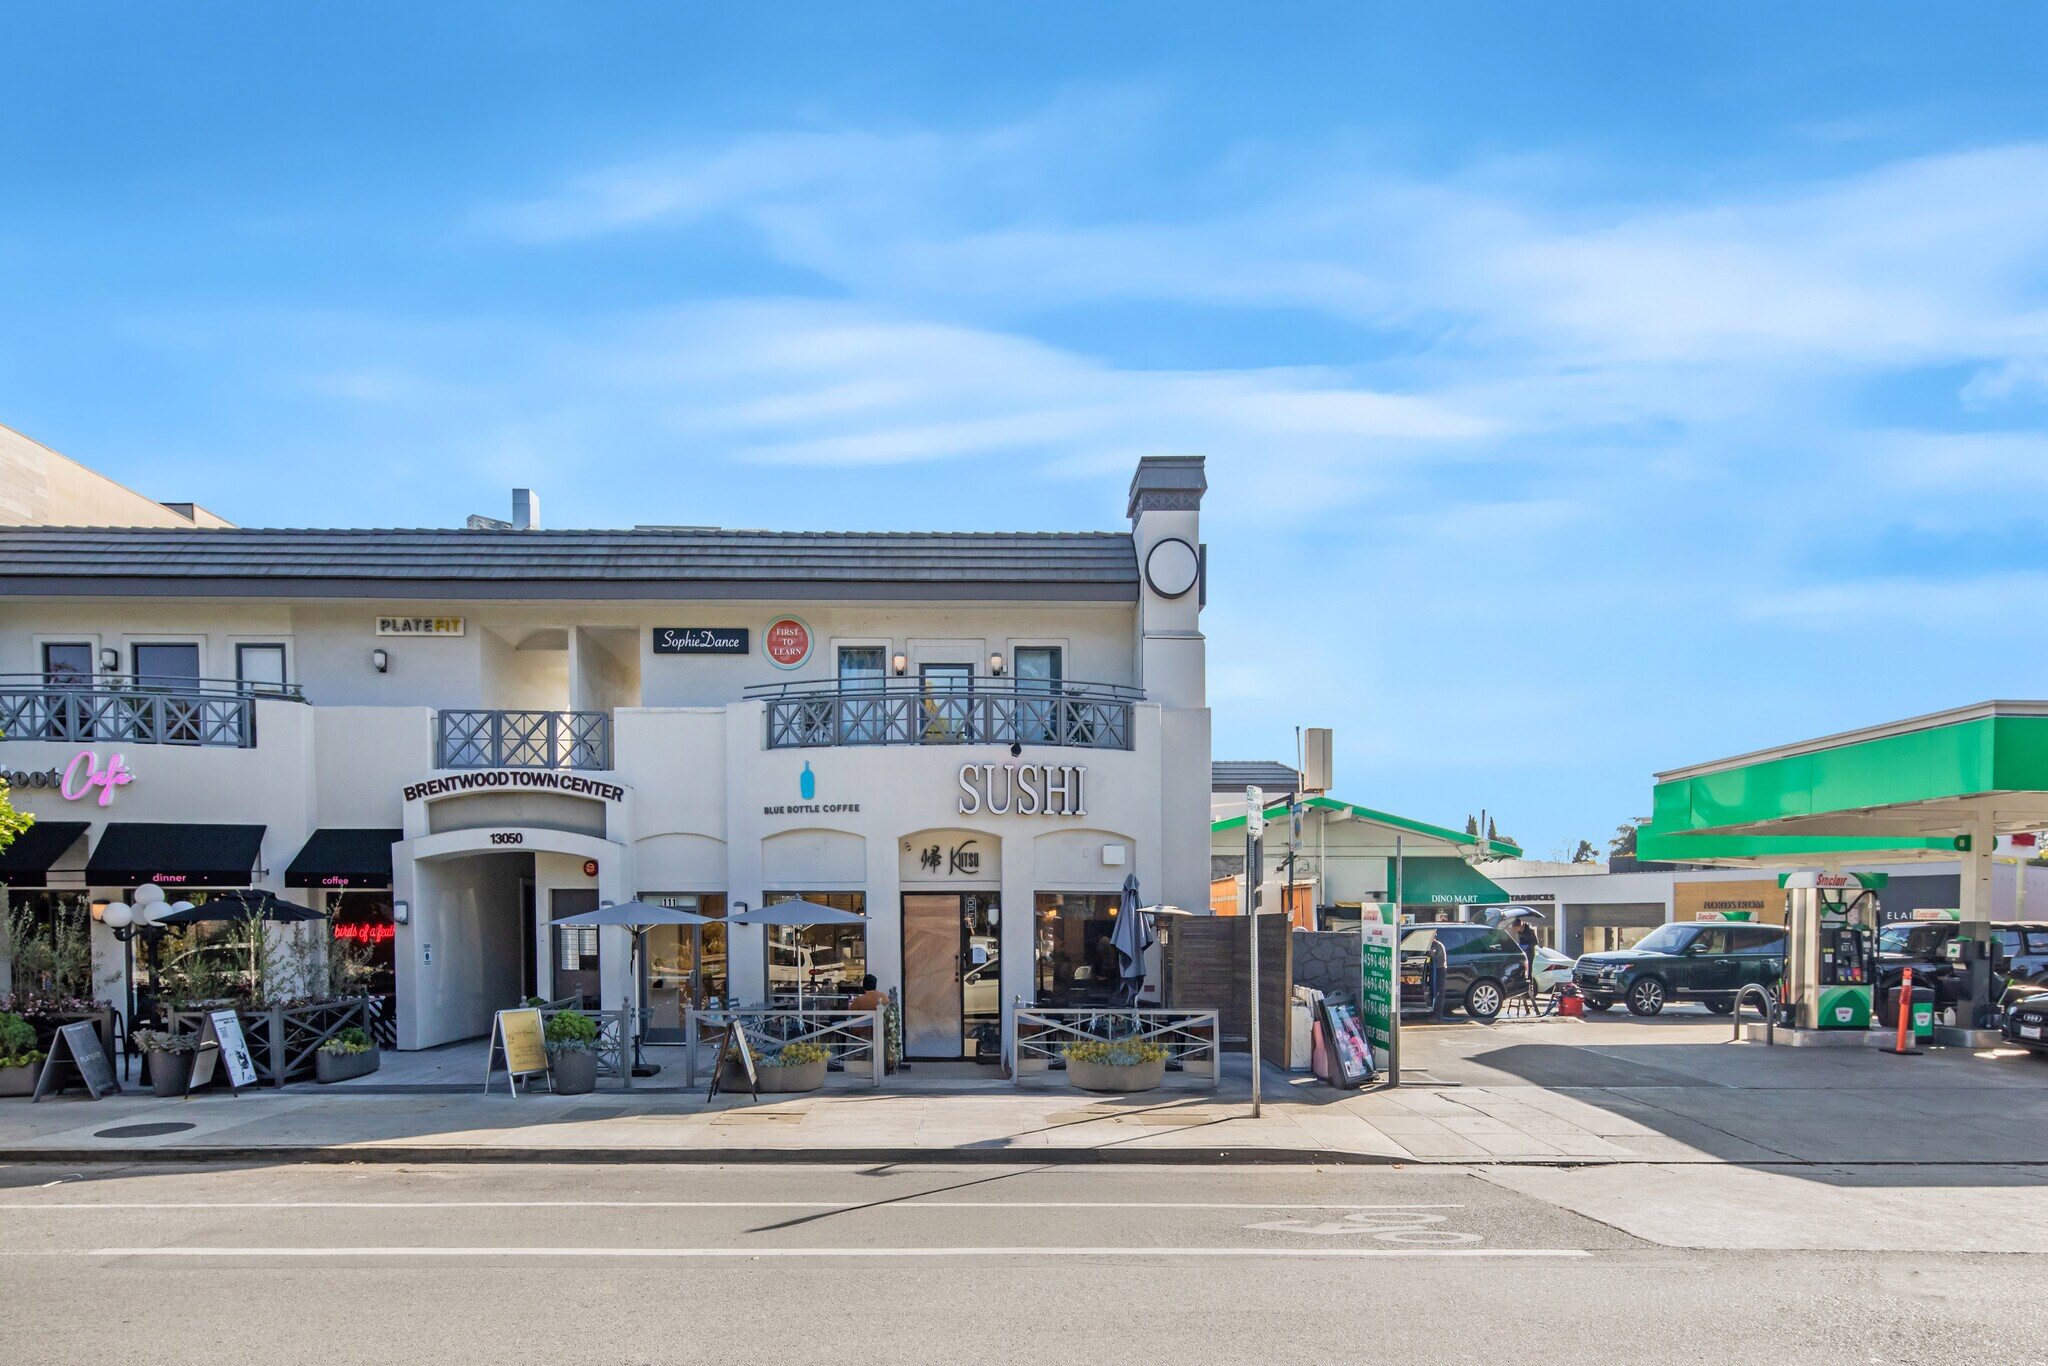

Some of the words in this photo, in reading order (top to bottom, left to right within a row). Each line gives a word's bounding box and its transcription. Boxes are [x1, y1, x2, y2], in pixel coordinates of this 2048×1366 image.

[380, 618, 461, 632] PLATEFIT
[776, 628, 799, 636] FIRST
[782, 638, 793, 646] TO
[773, 648, 802, 656] LEARN
[403, 771, 509, 802] BRENTWOOD
[510, 771, 558, 788] TOWN
[559, 775, 625, 803] CENTER
[958, 763, 1088, 816] SUSHI
[764, 806, 785, 815] BLUE
[787, 805, 820, 814] BOTTLE
[822, 803, 860, 812] COFFEE
[490, 832, 523, 845] 13050
[1959, 839, 1965, 847] 8
[152, 873, 187, 883] dinner
[322, 876, 349, 885] coffee
[1816, 873, 1848, 887] Sinclair
[662, 898, 677, 907] 111
[1431, 894, 1452, 903] DINO
[1454, 894, 1479, 903] MART
[1703, 901, 1764, 909] NORDSTROM
[335, 923, 358, 938] birds
[359, 923, 370, 943] of
[370, 928, 377, 938] a
